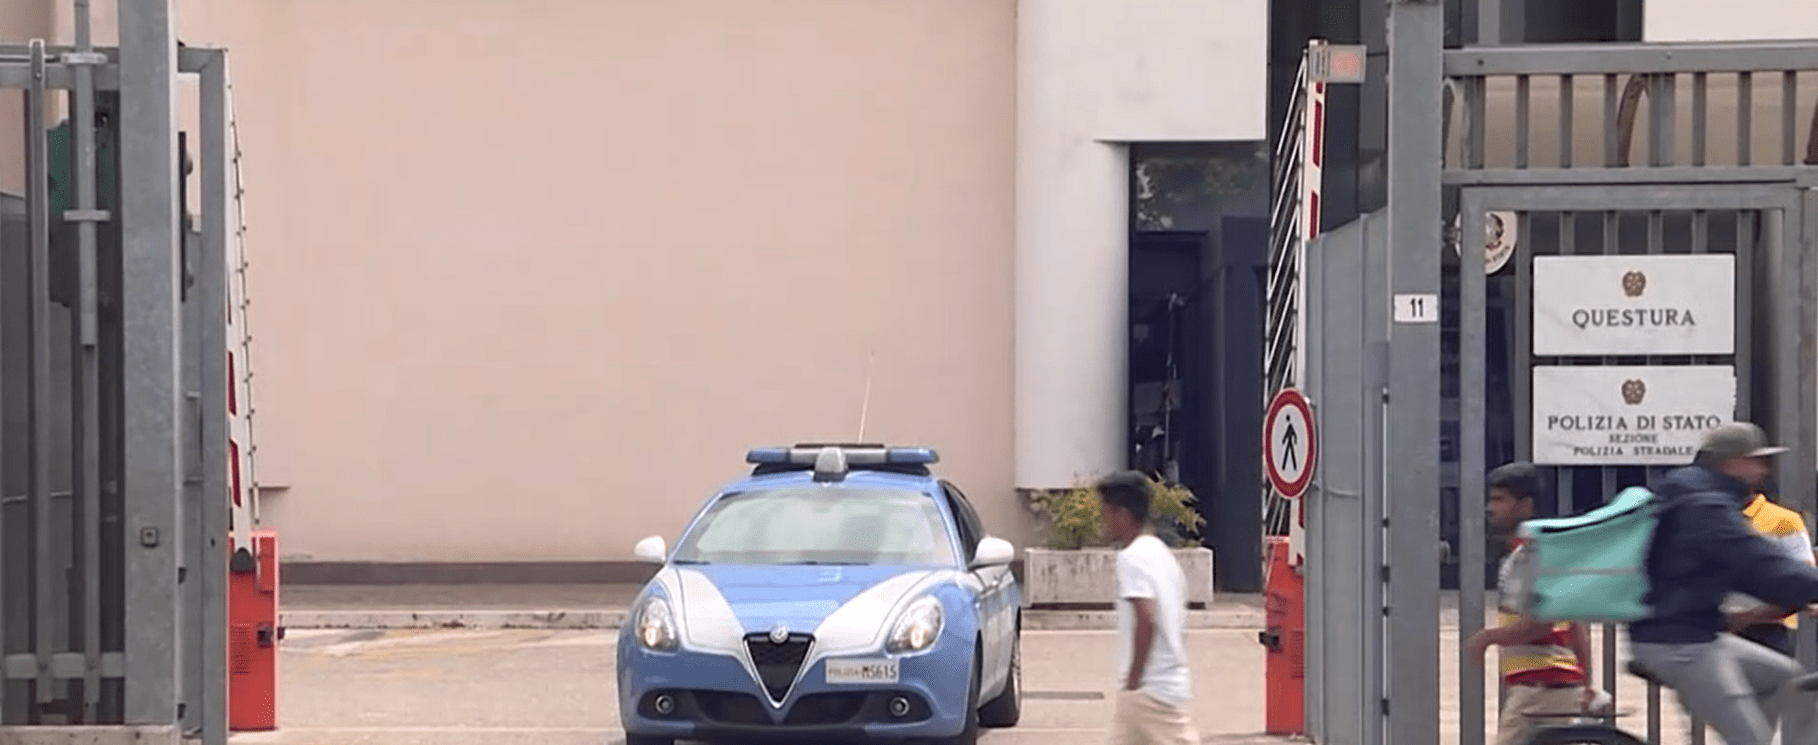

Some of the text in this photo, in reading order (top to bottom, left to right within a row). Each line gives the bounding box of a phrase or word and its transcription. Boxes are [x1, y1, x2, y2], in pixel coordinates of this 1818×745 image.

[1410, 298, 1423, 317] 11
[1572, 309, 1695, 329] QUESTURA
[1548, 415, 1721, 430] POLIZIA DI STATO
[1609, 433, 1657, 444] SEZIONE
[1573, 446, 1693, 456] POLIZIA STRADALE
[862, 664, 897, 679] M5615
